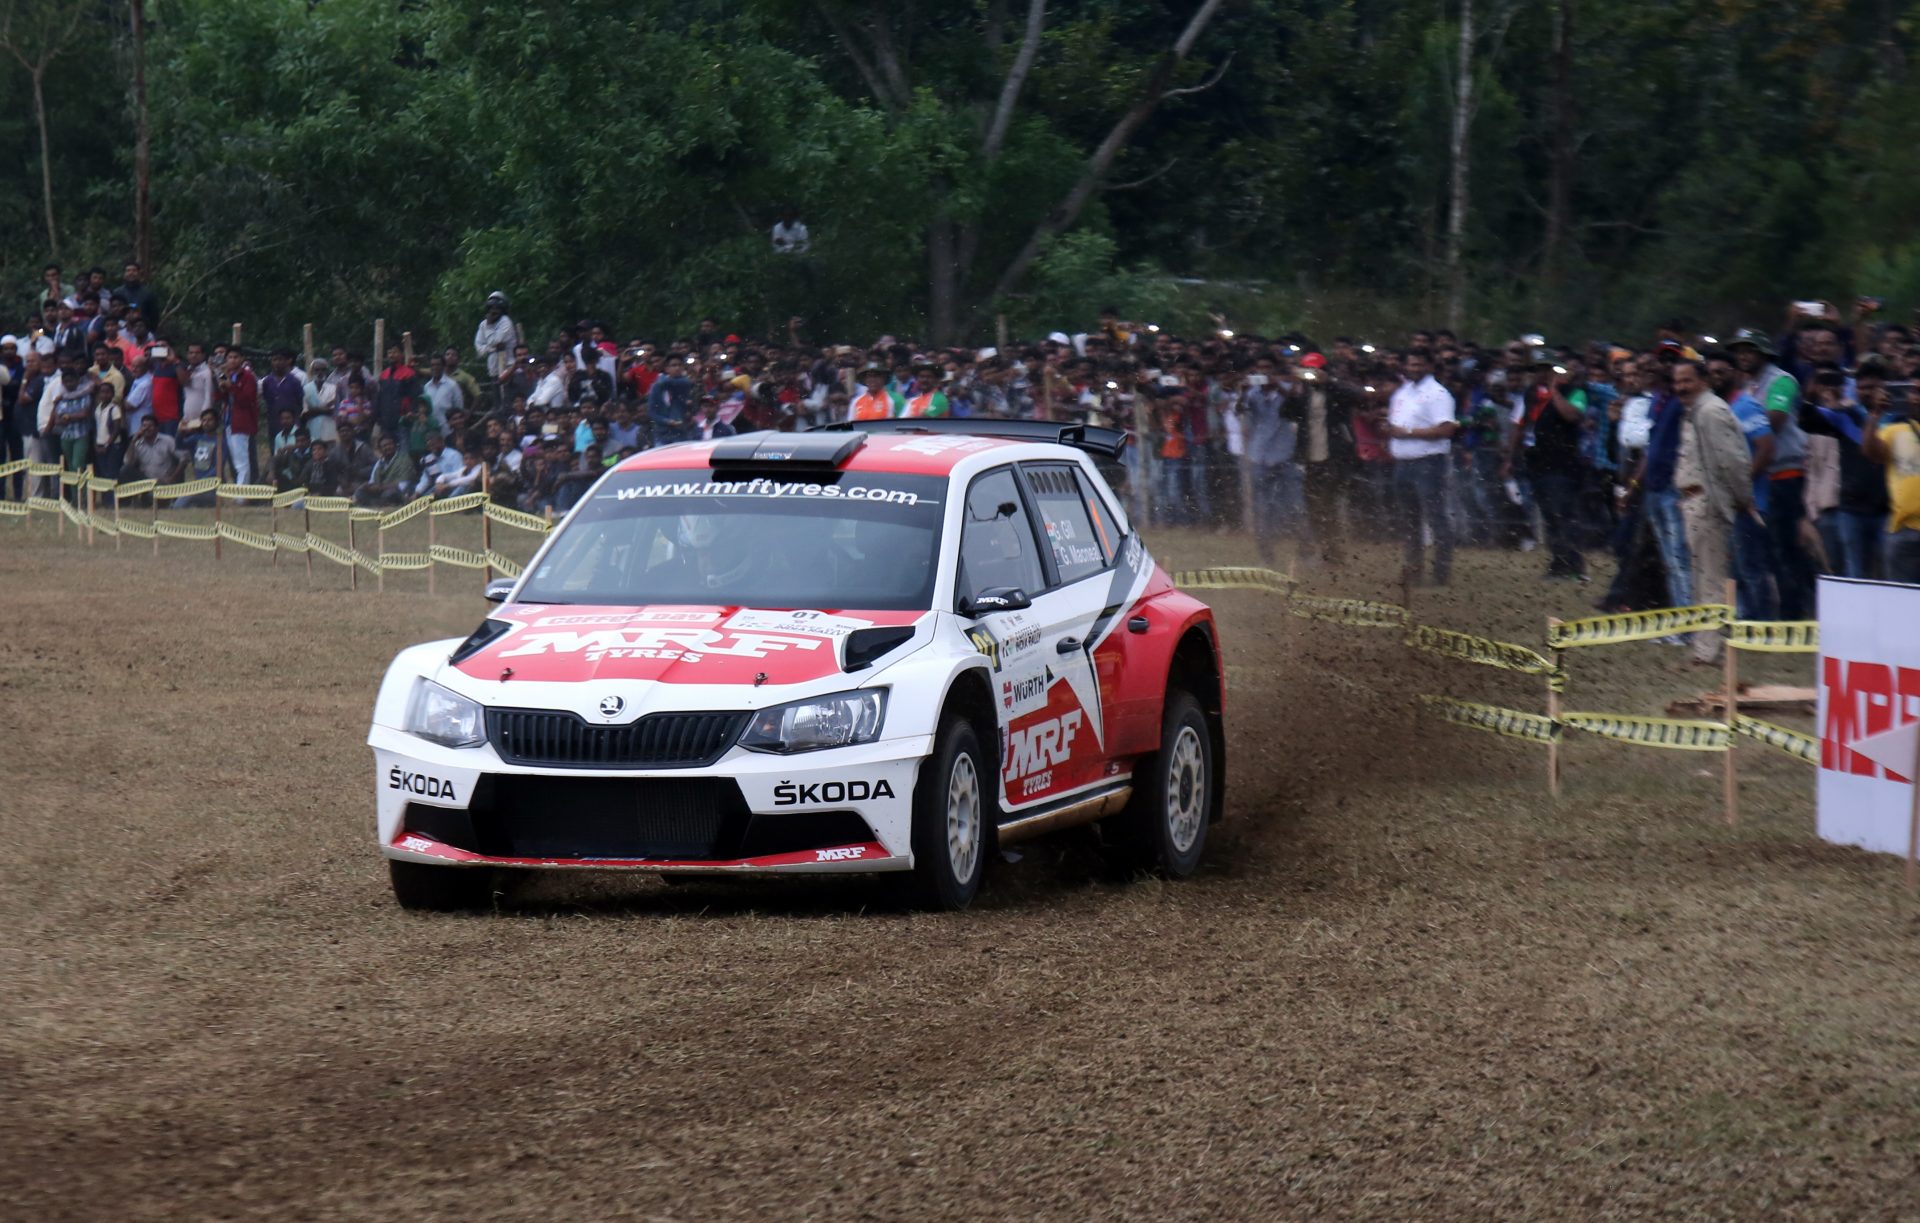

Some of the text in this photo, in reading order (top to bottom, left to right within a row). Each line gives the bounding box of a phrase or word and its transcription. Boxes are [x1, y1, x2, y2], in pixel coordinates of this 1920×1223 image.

[616, 478, 918, 505] www.mrftyres.com
[791, 612, 820, 620] 01
[497, 627, 823, 659] MRF
[584, 649, 703, 663] TYRES
[1013, 675, 1045, 703] WÜRTH
[1005, 708, 1082, 783] MRF
[389, 764, 456, 801] ŠKODA
[773, 779, 896, 806] ŠKODA
[1023, 770, 1053, 797] TYRES
[815, 846, 866, 862] MRF
